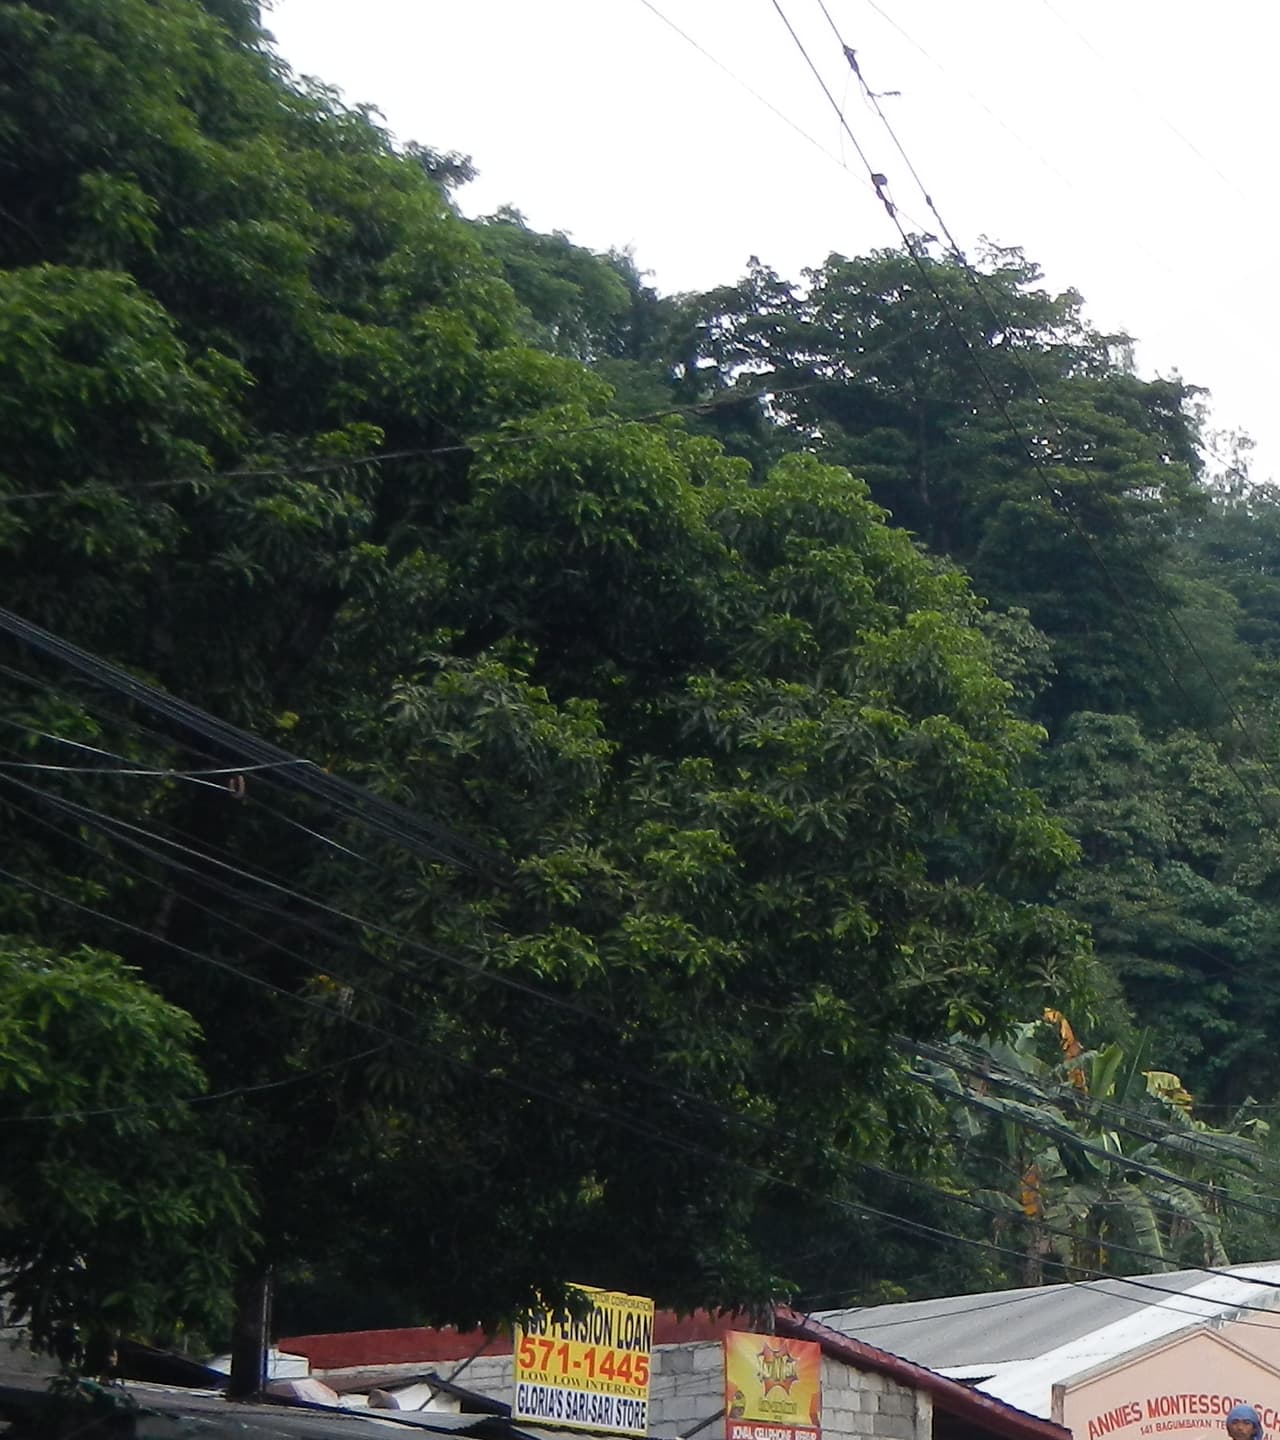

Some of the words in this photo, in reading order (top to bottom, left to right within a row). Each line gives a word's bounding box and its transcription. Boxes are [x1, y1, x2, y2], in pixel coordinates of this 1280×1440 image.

[617, 1309, 652, 1354] LOAN
[518, 1337, 649, 1387] 571-1445
[520, 1371, 548, 1382] LOW
[554, 1375, 581, 1386] LOW
[518, 1384, 563, 1418] GLORIA'S
[566, 1392, 613, 1425] SARI-SARI
[616, 1399, 646, 1430] STORE
[1088, 1402, 1143, 1440] ANNIE'S
[1156, 1419, 1211, 1431] BAGUMBAYAN
